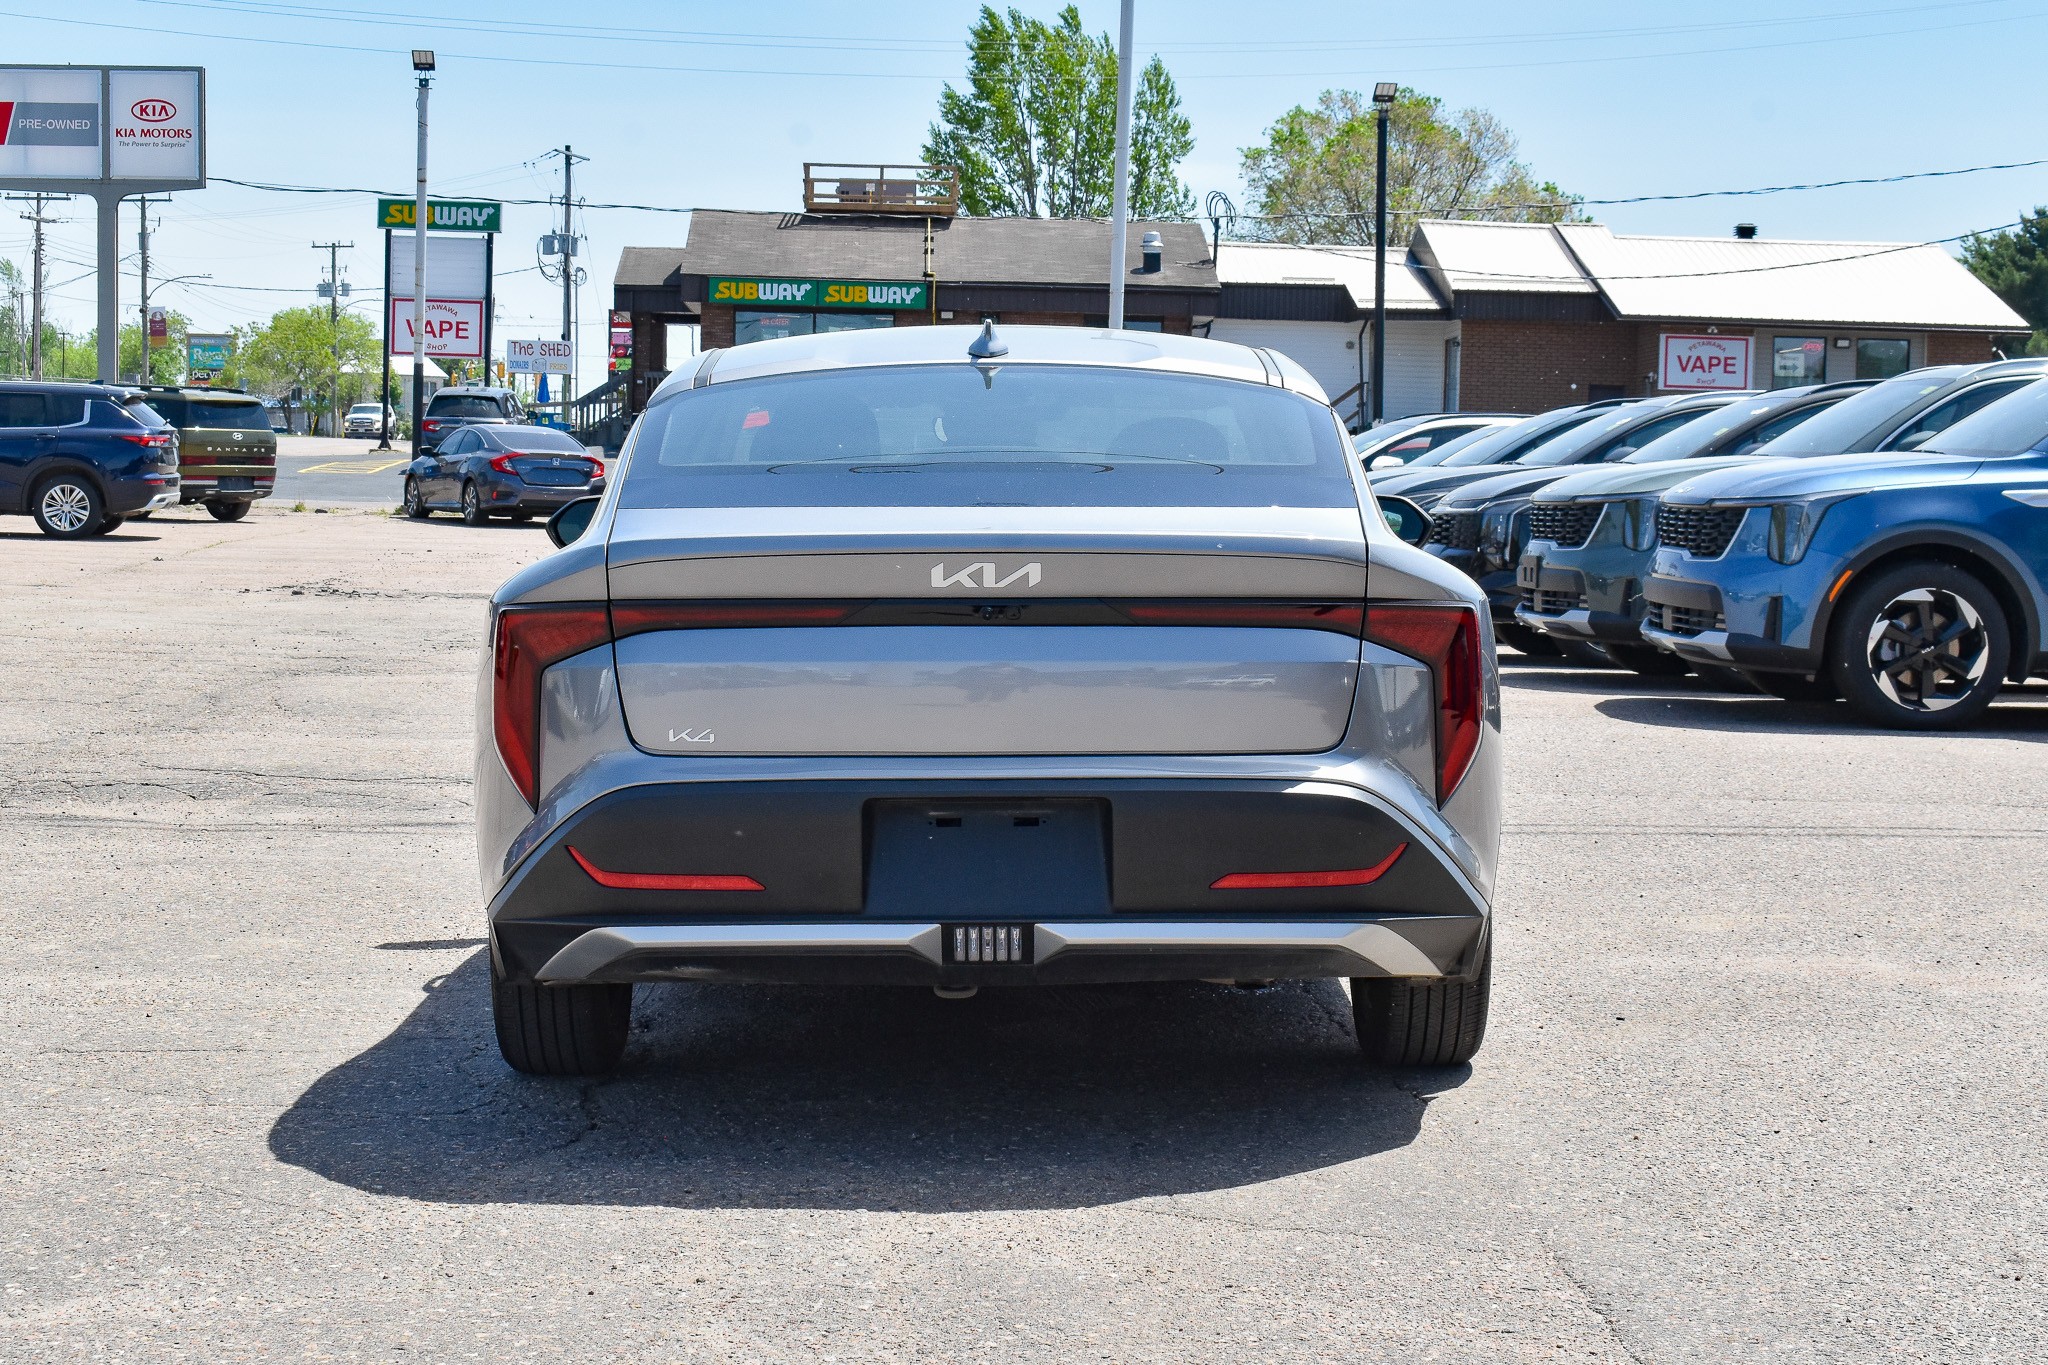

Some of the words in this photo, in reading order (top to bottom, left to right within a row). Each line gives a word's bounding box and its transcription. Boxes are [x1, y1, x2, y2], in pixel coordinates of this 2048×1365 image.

[139, 104, 169, 117] KIA
[18, 118, 91, 130] PRE-OWNED
[115, 128, 136, 138] KIA
[140, 128, 192, 139] MOTORS
[131, 140, 152, 148] Power
[160, 141, 186, 149] Surprise
[714, 281, 812, 301] SUBWAY
[824, 285, 922, 305] SUBWAY
[425, 304, 459, 317] TAWAWA
[426, 343, 448, 351] SHOP
[511, 341, 535, 356] The
[539, 343, 571, 357] SHED
[1676, 354, 1737, 374] VAPE
[1696, 378, 1716, 386] SHOP
[930, 562, 1042, 588] KIA
[668, 728, 715, 744] K4
